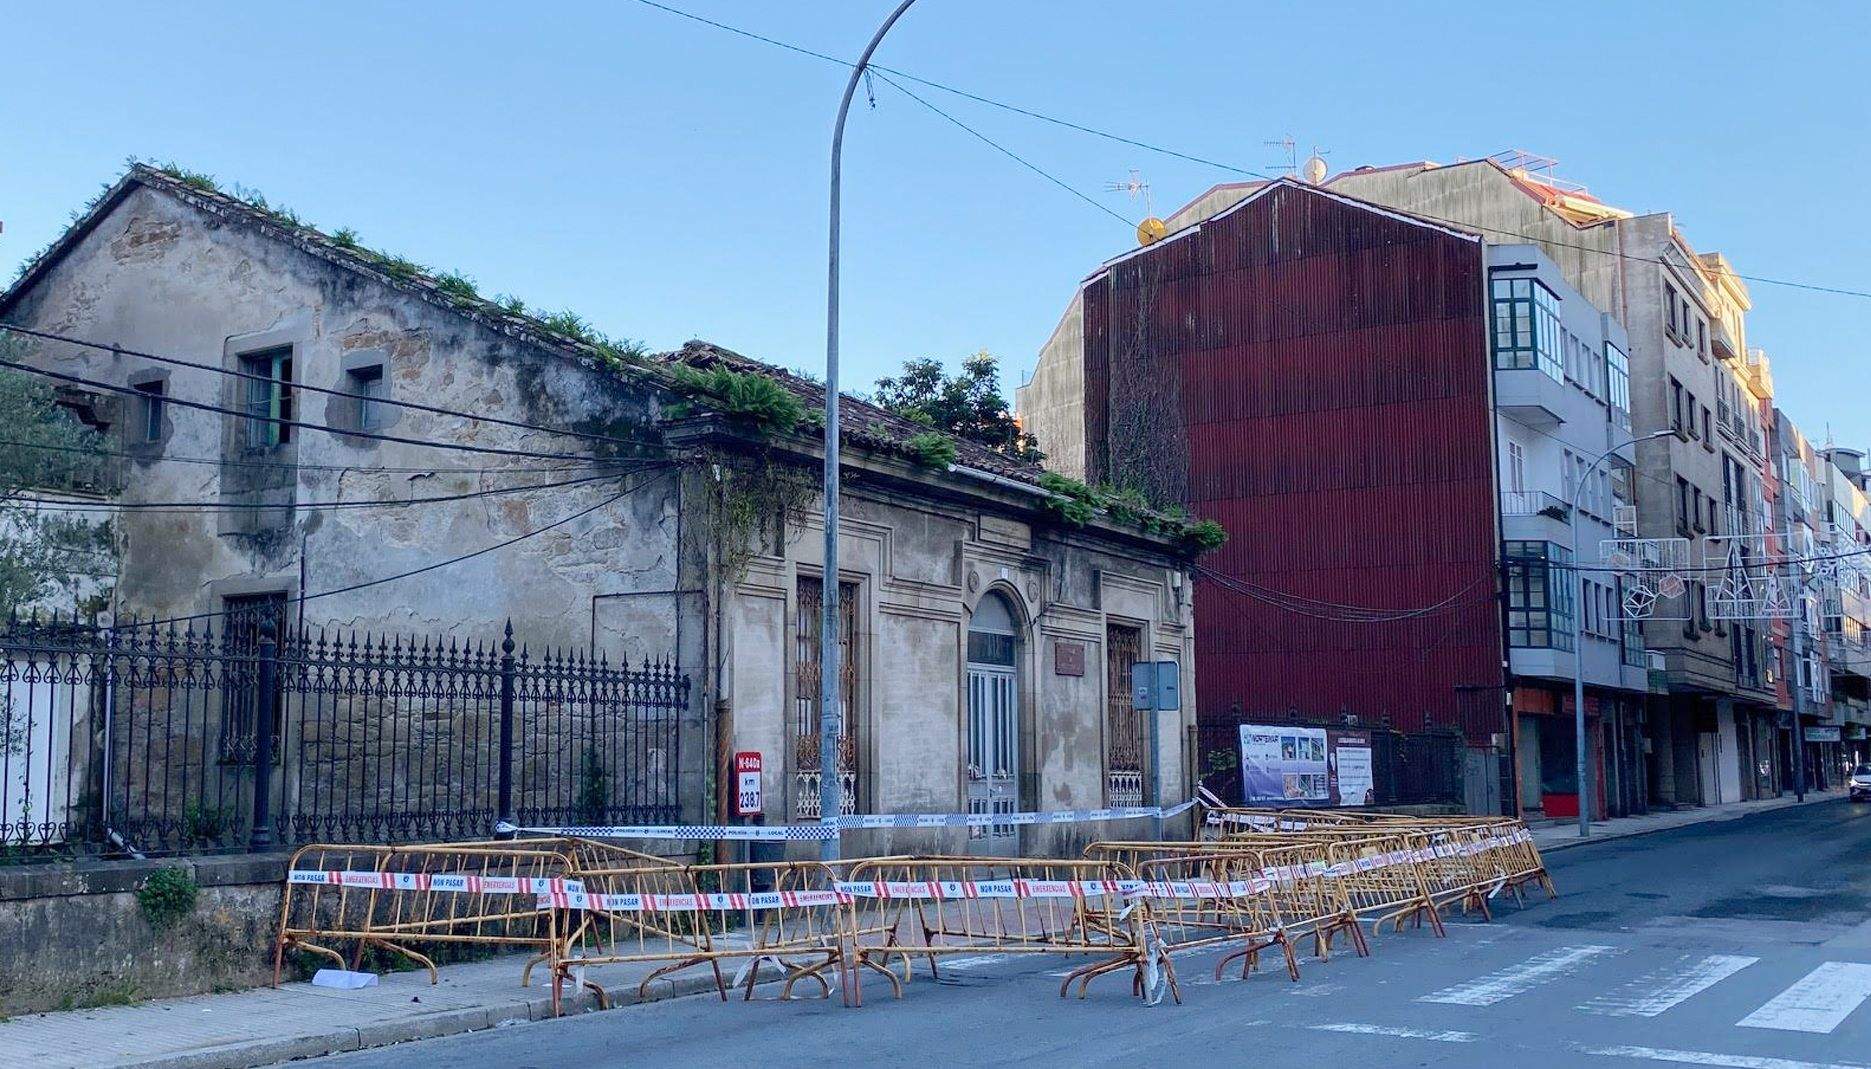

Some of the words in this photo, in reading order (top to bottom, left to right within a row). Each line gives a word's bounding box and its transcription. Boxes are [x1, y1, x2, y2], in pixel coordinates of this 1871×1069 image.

[745, 778, 755, 786] km
[432, 878, 445, 886] NON
[445, 878, 464, 887] PASAR
[853, 885, 872, 893] PASAR
[980, 884, 992, 892] NON
[993, 884, 1012, 893] PASAR
[620, 898, 639, 906] PASAR
[761, 896, 779, 904] PASAR
